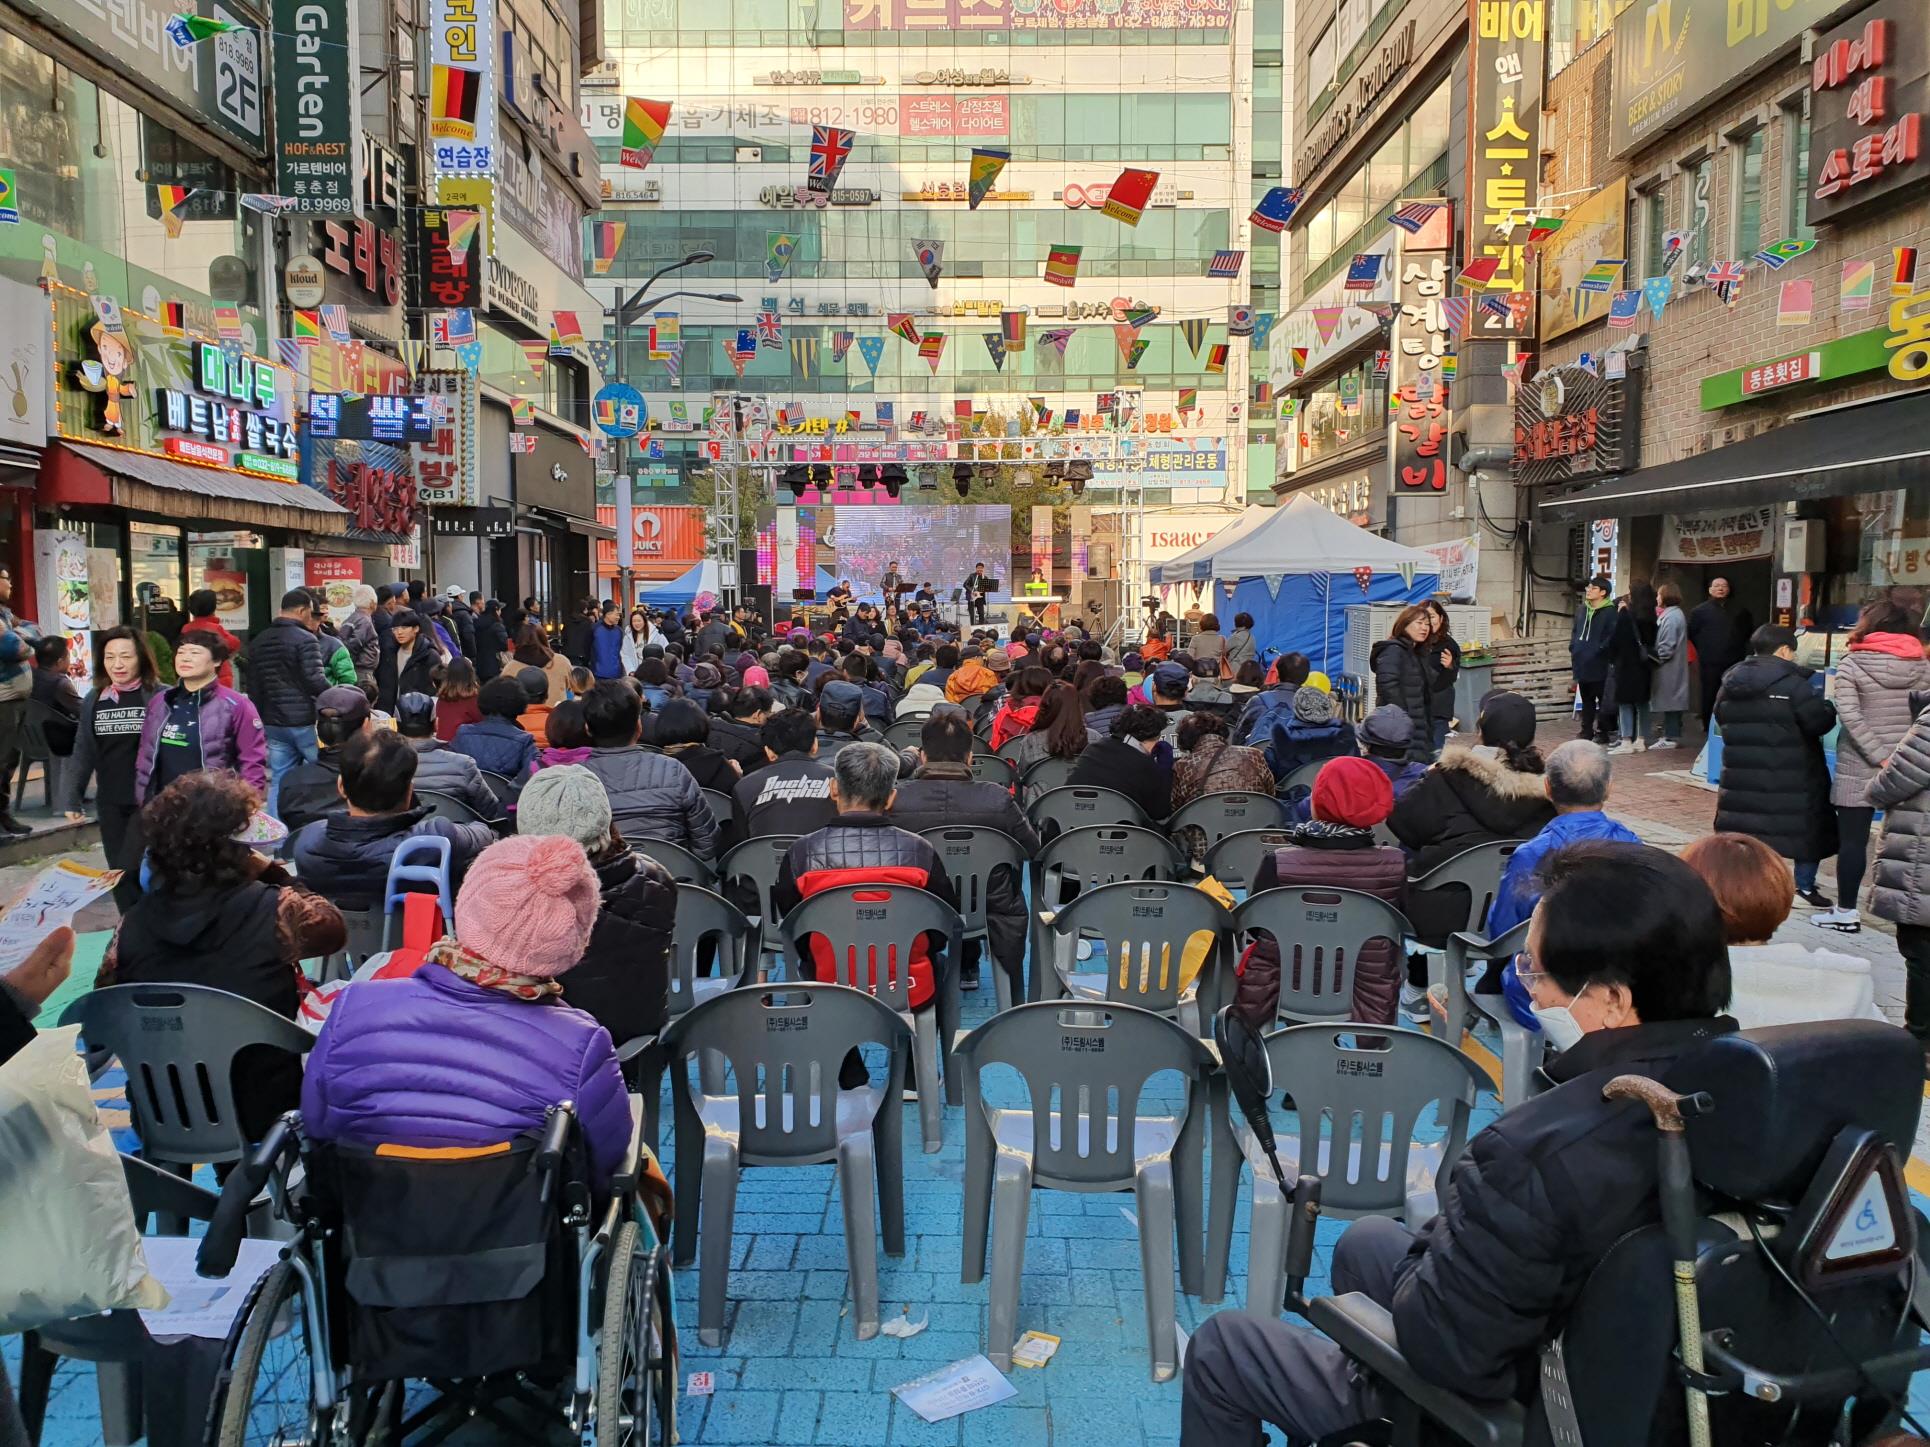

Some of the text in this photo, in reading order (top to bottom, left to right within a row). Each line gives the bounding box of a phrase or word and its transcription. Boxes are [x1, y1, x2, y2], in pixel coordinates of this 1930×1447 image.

[1480, 0, 1542, 42] 비어
[1813, 18, 1887, 93] 비어
[295, 5, 329, 137] Garten
[1495, 52, 1523, 85] 앤
[219, 61, 257, 122] 2F
[1656, 70, 1686, 106] STORY
[908, 100, 952, 113] 스트레스
[961, 100, 1003, 114] 감정조절
[1846, 75, 1886, 127] 앤
[809, 106, 898, 126] 812-1980
[909, 117, 952, 131] 헬스케어
[961, 117, 1004, 130] 다이어트
[430, 120, 474, 138] Welcome
[437, 146, 491, 169] 연습장
[1815, 112, 1922, 200] 스토리
[286, 162, 347, 176] 가르텐비어
[831, 190, 870, 202] 815-0597
[1104, 201, 1139, 223] Welcome
[1250, 212, 1284, 233] Welcome
[325, 218, 400, 306] 노래방
[1401, 258, 1451, 371] 삼계탕
[200, 342, 276, 409] 대나무
[1749, 358, 1802, 391] 동춘횟집
[165, 388, 229, 443] 베트남
[246, 412, 298, 459] 쌀국수
[1149, 453, 1218, 470] 체형관리운동
[433, 489, 455, 499] B1
[633, 541, 663, 552] JUICY
[96, 711, 110, 721] YOU
[110, 710, 126, 720] HAD
[127, 709, 139, 719] ME
[97, 726, 114, 735] HATE
[766, 1016, 808, 1029] (주)드림시스템
[1061, 1035, 1105, 1048] (주)드림시스템
[1336, 1059, 1384, 1072] (주)드림시스템
